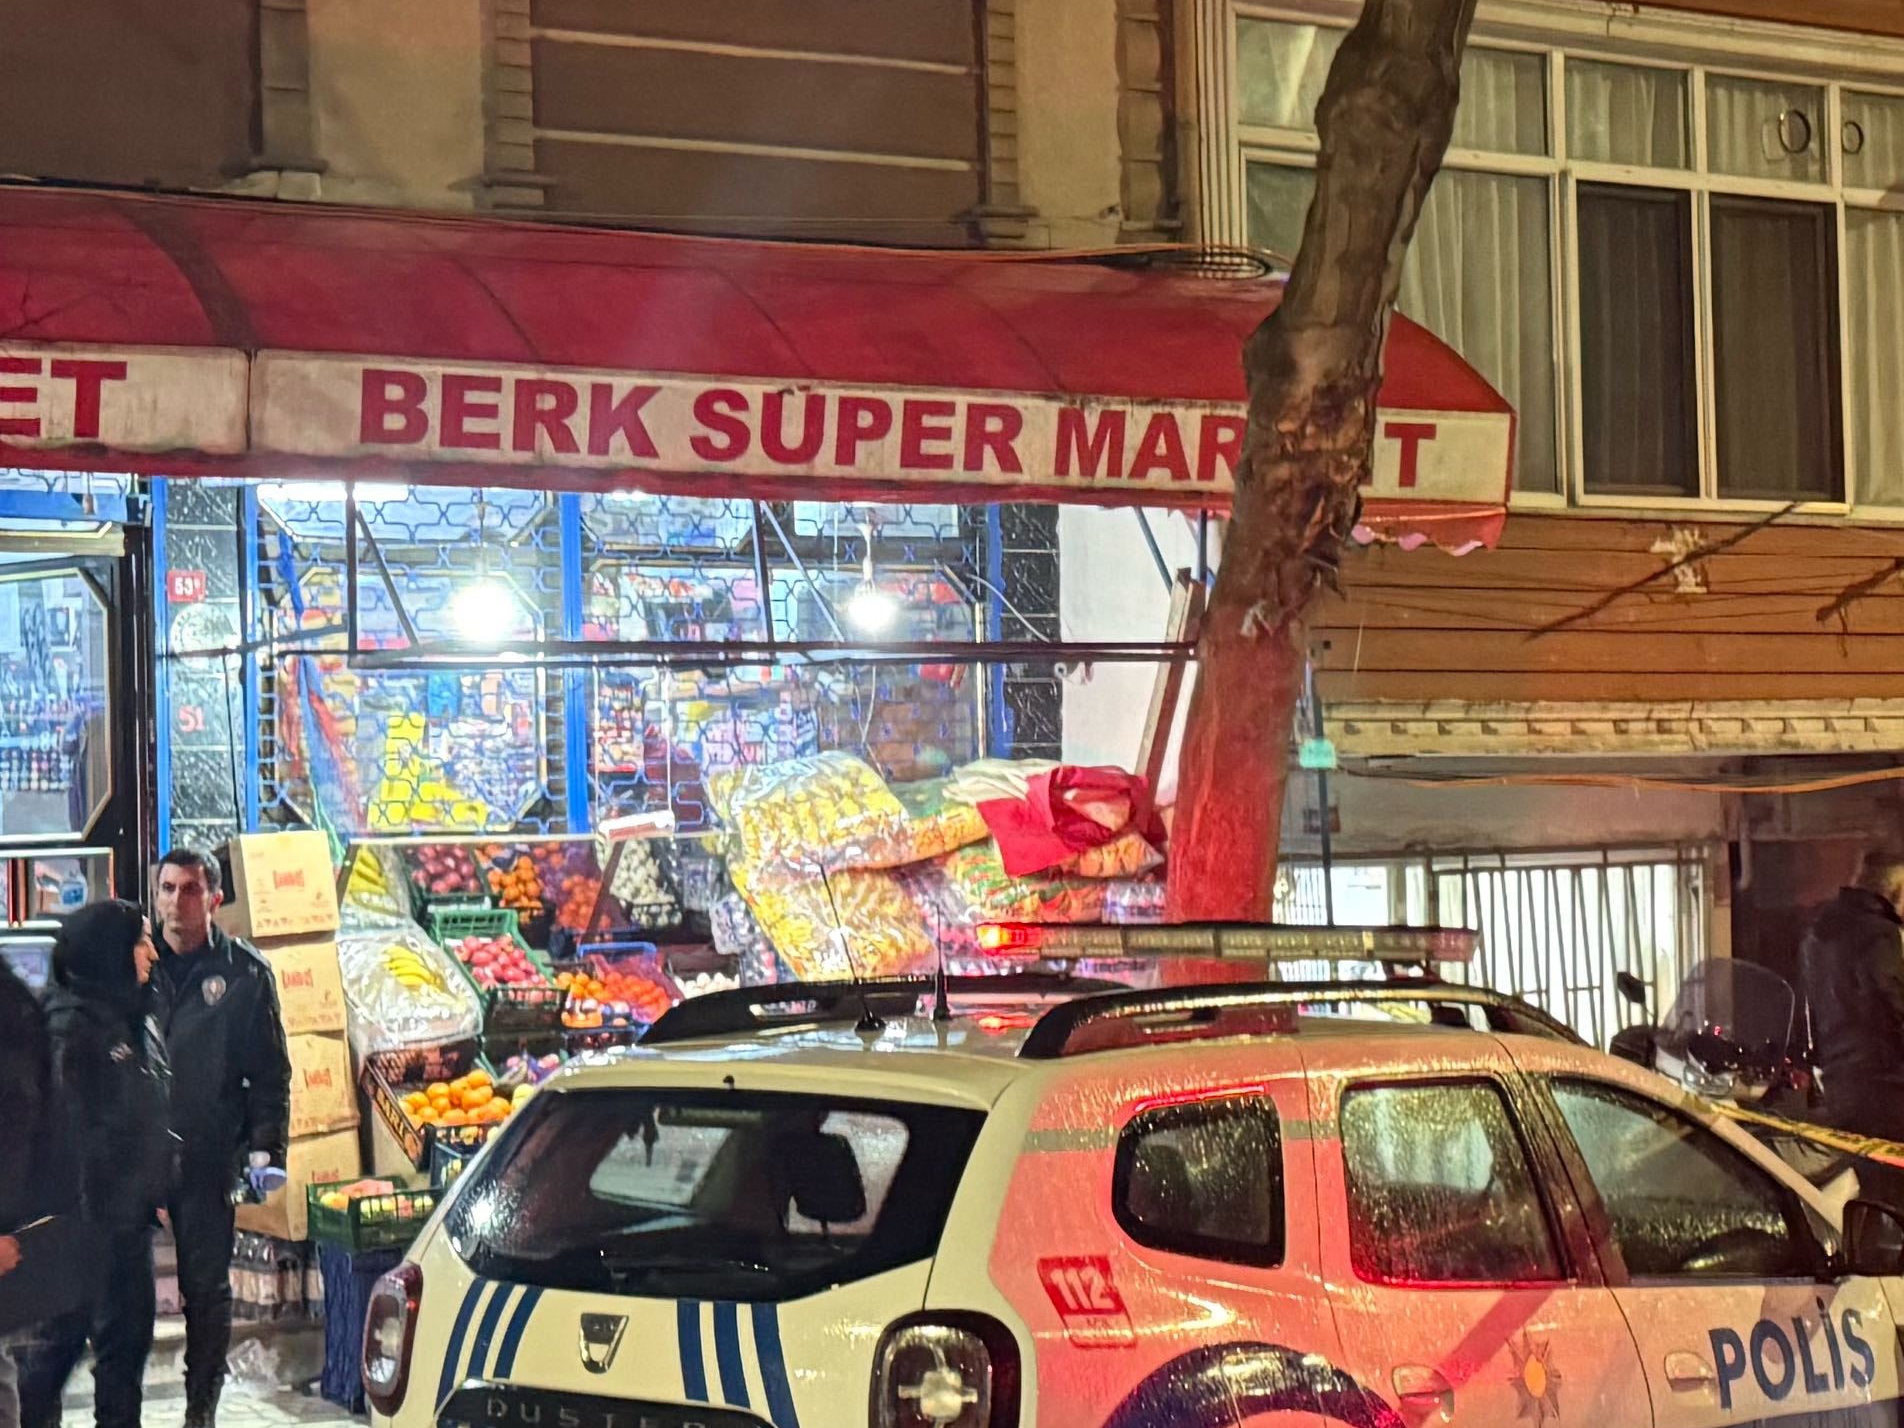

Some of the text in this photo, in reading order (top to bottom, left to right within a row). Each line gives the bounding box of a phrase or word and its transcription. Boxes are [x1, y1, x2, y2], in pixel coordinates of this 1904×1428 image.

[358, 369, 661, 459] BERK
[1053, 406, 1438, 488] MART
[1049, 1265, 1116, 1311] 112
[1708, 1296, 1875, 1410] POLİS
